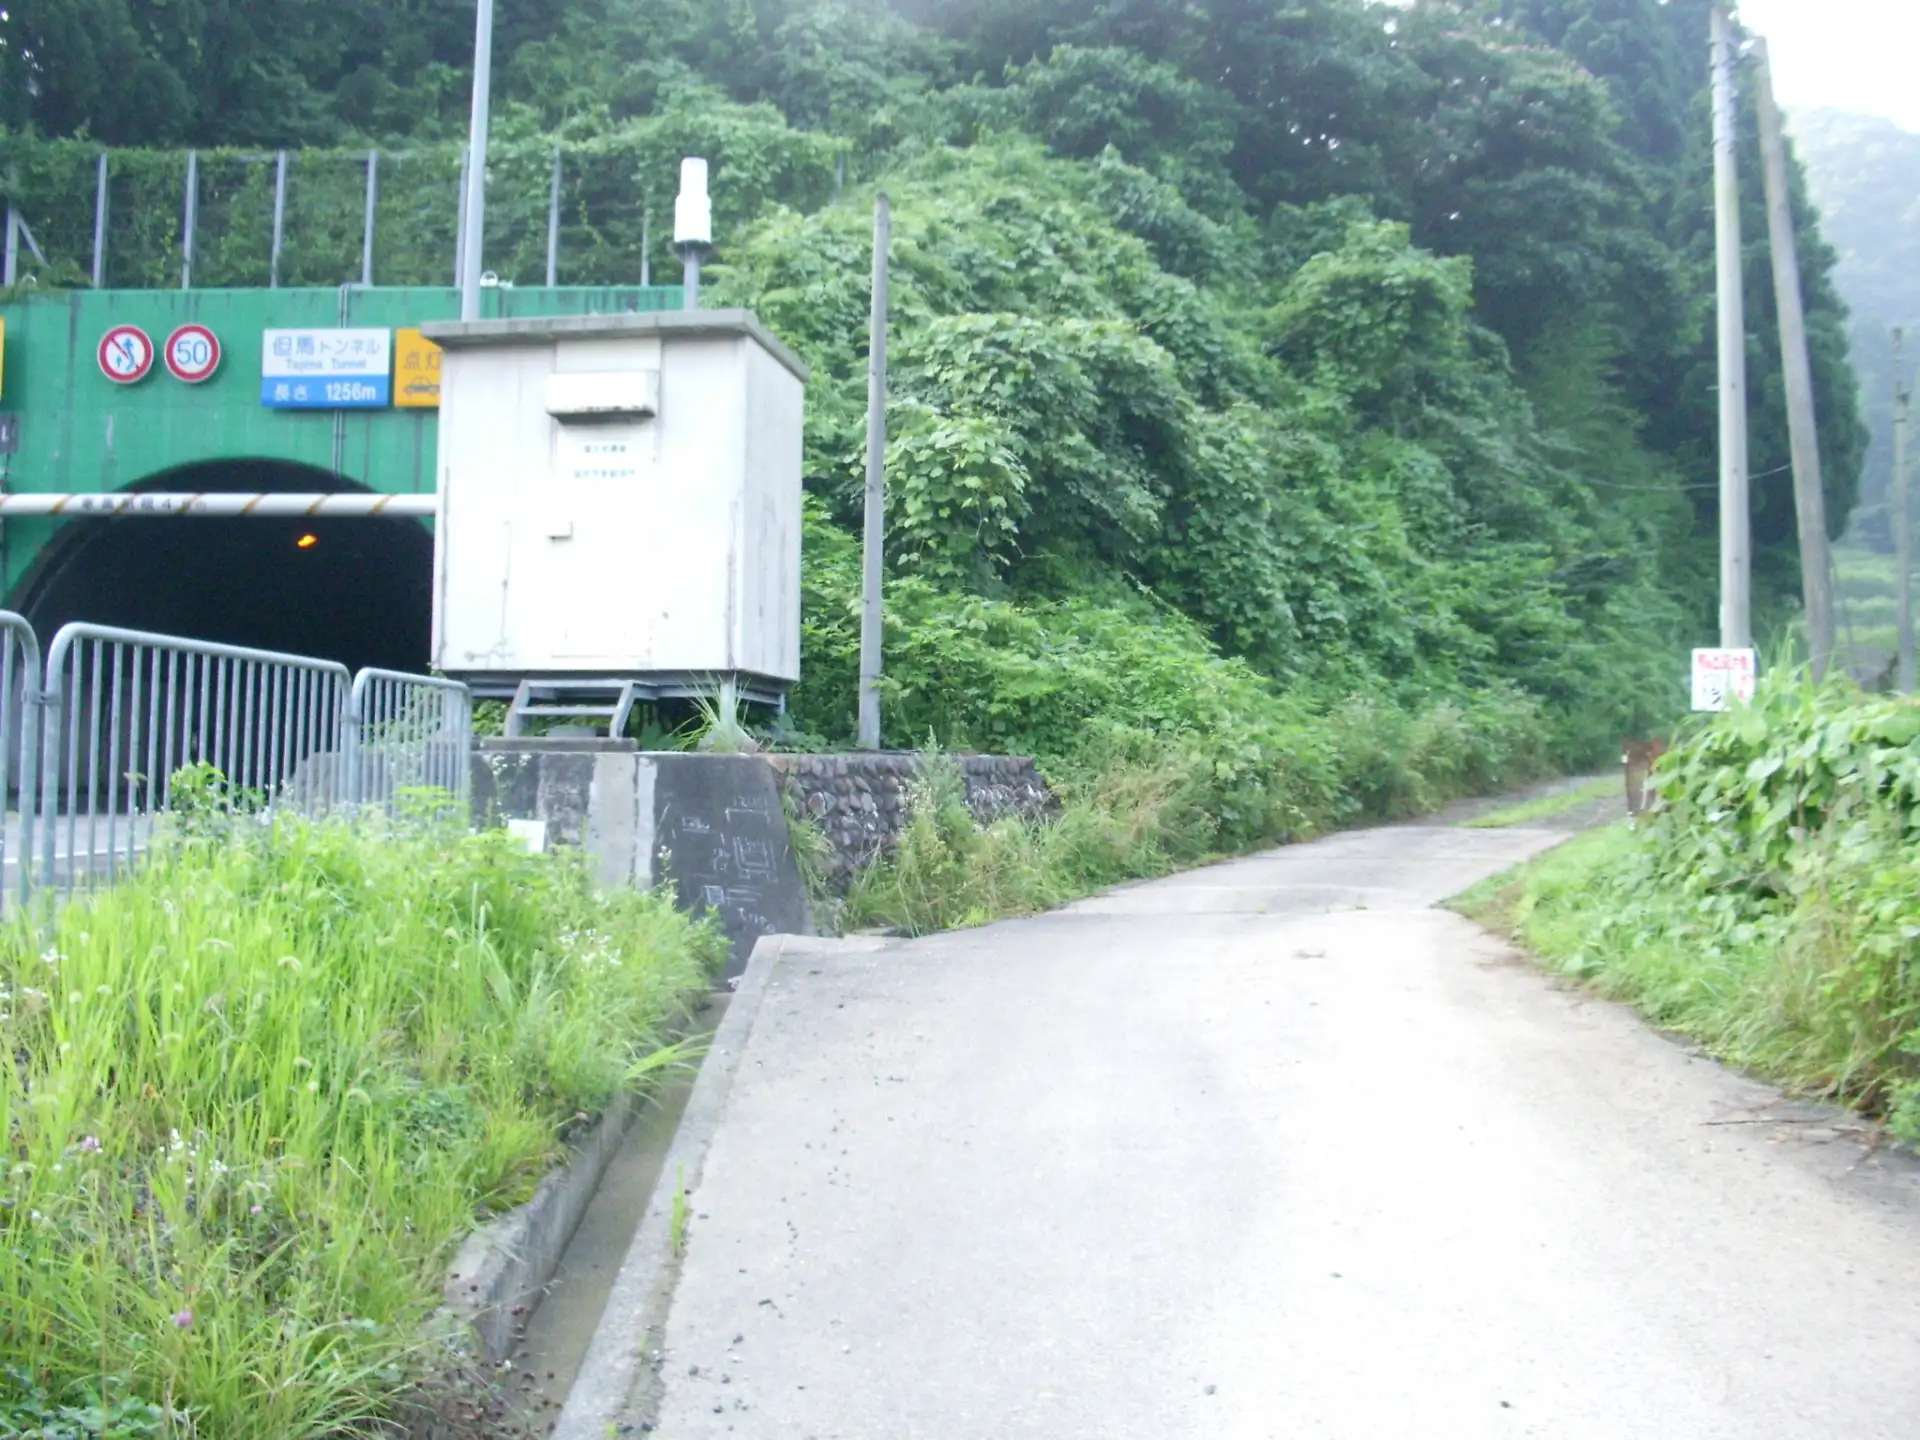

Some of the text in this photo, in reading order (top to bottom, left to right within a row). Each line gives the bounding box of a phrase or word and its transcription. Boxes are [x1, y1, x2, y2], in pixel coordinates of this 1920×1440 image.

[176, 340, 208, 365] 50
[273, 336, 381, 356] 但馬トンネル
[332, 358, 367, 370] Tunnel
[275, 382, 376, 402] 長さ 1256m
